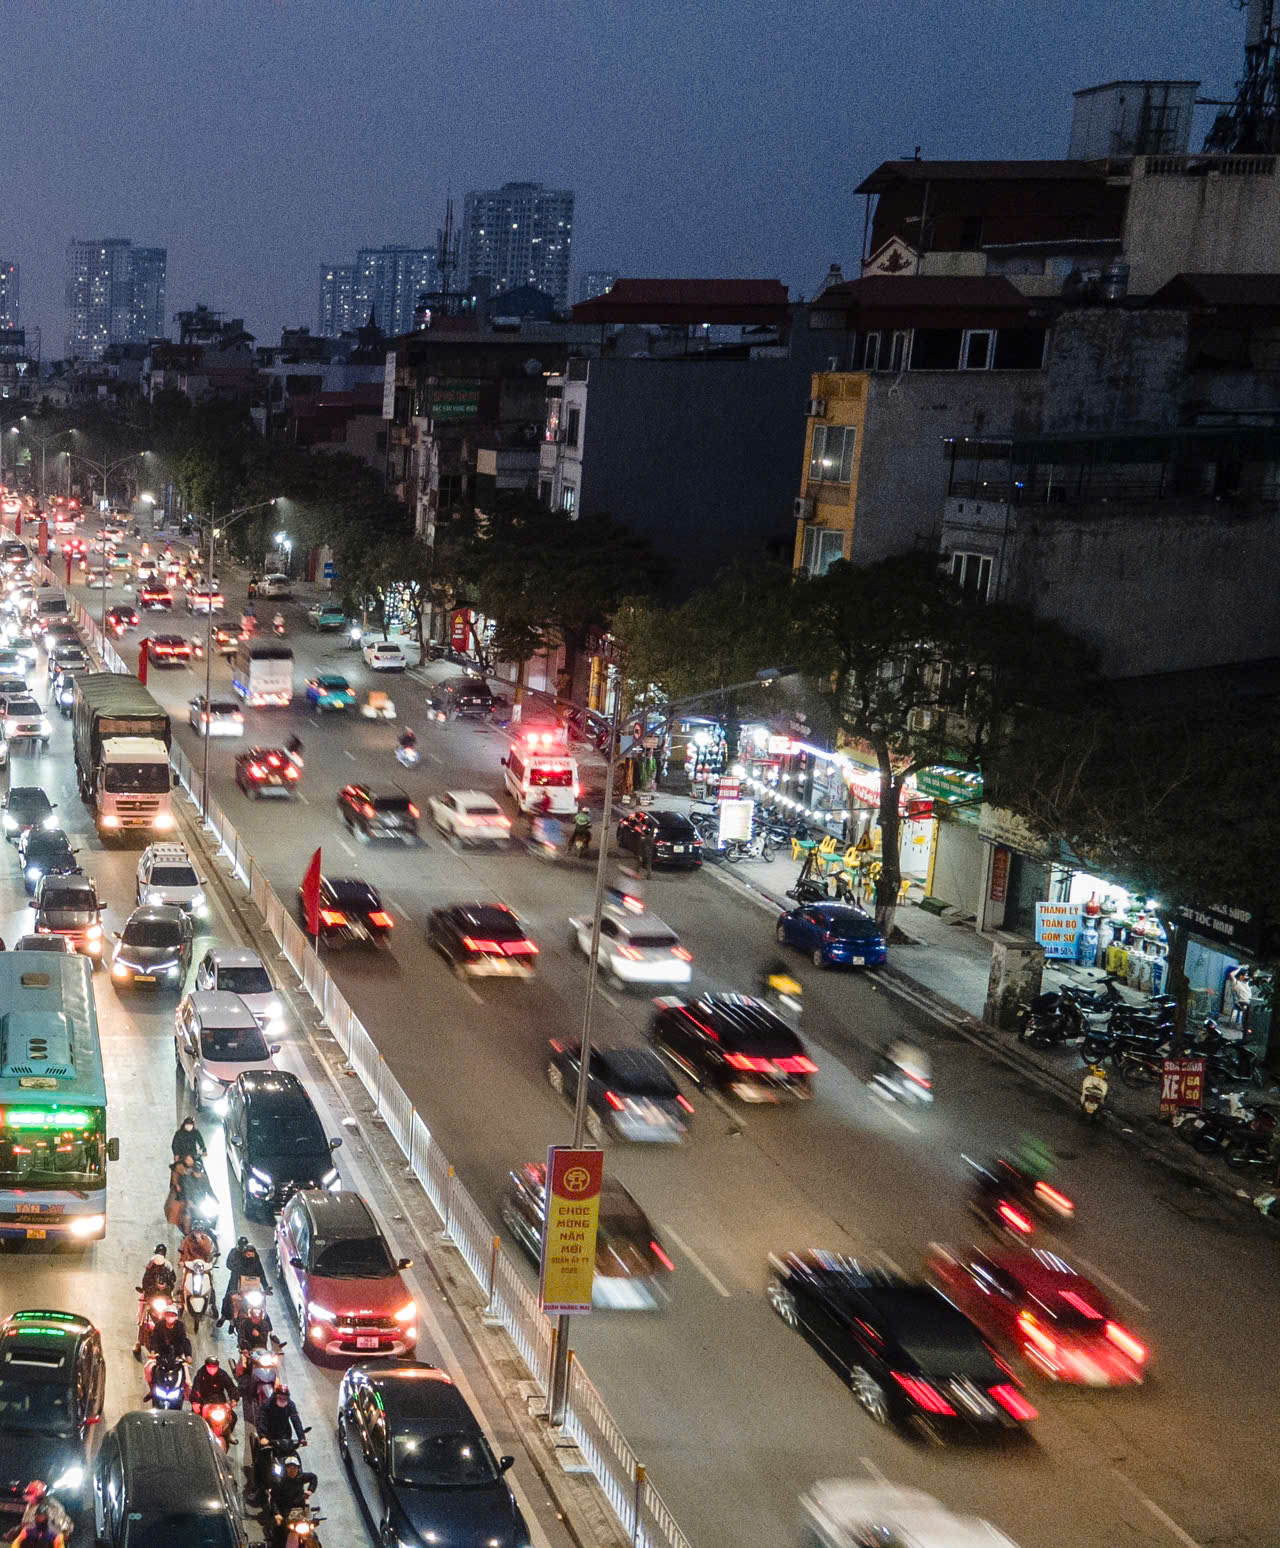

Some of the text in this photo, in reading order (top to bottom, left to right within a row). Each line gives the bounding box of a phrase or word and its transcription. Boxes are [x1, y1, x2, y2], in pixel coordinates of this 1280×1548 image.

[1040, 906, 1067, 914] THANH
[1041, 918, 1063, 927] TOÀN
[1162, 1074, 1180, 1100] XE
